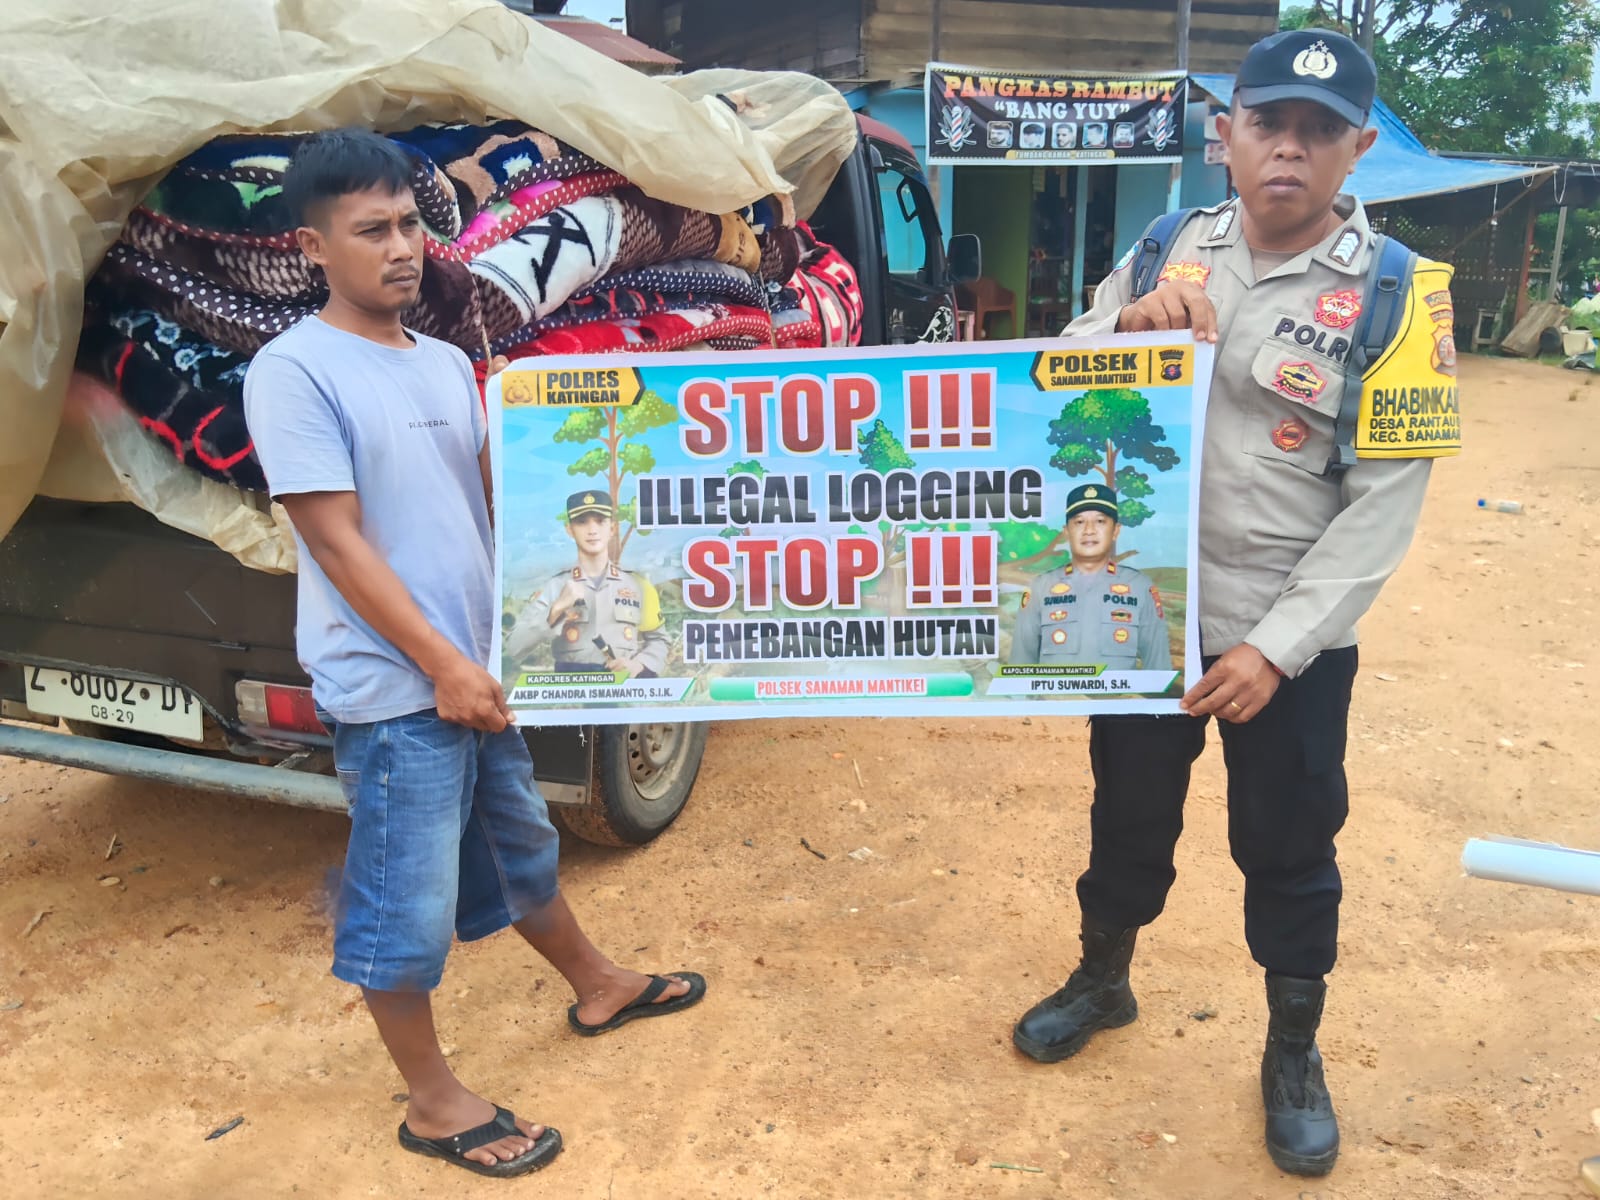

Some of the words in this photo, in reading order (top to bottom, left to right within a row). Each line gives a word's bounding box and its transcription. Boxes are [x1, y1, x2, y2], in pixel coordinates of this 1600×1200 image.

[943, 75, 1068, 98] PANGKAS
[1071, 81, 1176, 103] RAMBUT
[1049, 353, 1138, 373] POLSEK
[546, 370, 620, 390] POLRES
[1050, 374, 1093, 386] SANAMAN
[1095, 373, 1137, 385] MANTIKEI
[546, 390, 620, 405] KATINGAN
[683, 377, 876, 455] STOP
[908, 372, 992, 449] !!!
[1369, 417, 1405, 430] DESA
[1369, 430, 1401, 443] KEC.
[638, 474, 816, 526] ILLEGAL
[828, 468, 1043, 523] LOGGING
[687, 537, 879, 609] STOP
[911, 534, 993, 604] !!!
[1103, 594, 1138, 607] POLRI
[685, 620, 885, 660] PENEBANGAN
[893, 617, 995, 656] HUTAN
[1002, 668, 1035, 676] KAPOLSEK
[1066, 667, 1095, 675] MANTIKEI
[526, 676, 571, 685] KAPOLRES
[572, 674, 615, 684] KATINGAN
[757, 680, 802, 696] POLSEK
[805, 678, 864, 695] SANAMAN
[867, 677, 925, 694] MANTIKEI
[1031, 680, 1055, 691] IPTU
[1057, 680, 1108, 691] SUWARDI,
[1110, 680, 1131, 690] S.H.
[513, 690, 539, 701] AKBP
[541, 688, 587, 700] CHANDRA
[588, 688, 647, 700] ISMAWANTO,
[649, 687, 673, 698] S.I.K.
